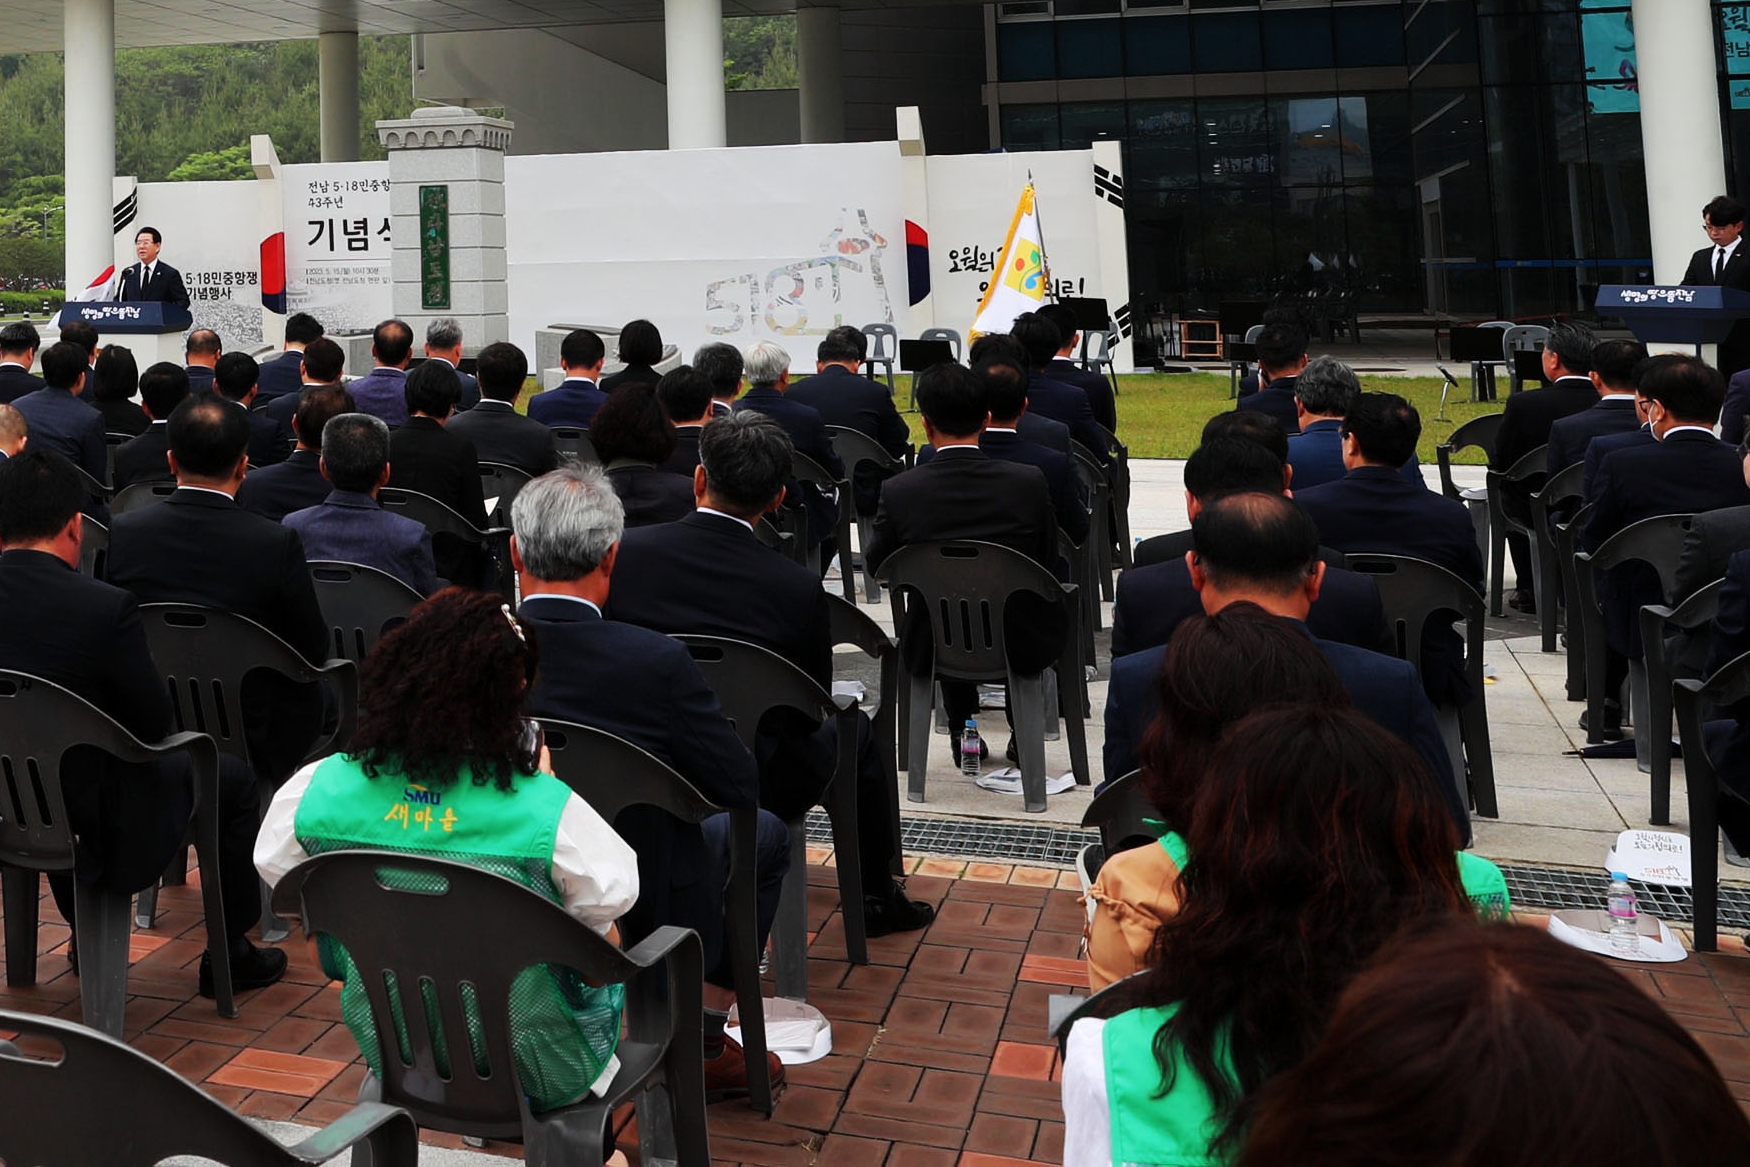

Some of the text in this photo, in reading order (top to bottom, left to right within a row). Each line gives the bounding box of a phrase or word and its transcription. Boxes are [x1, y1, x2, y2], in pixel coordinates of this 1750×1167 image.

[308, 180, 329, 194] 전남
[308, 196, 344, 209] 43주년
[949, 245, 995, 272] 오월의
[187, 286, 232, 300] 기념행사
[403, 787, 442, 805] SMU
[384, 802, 459, 832] 새마을
